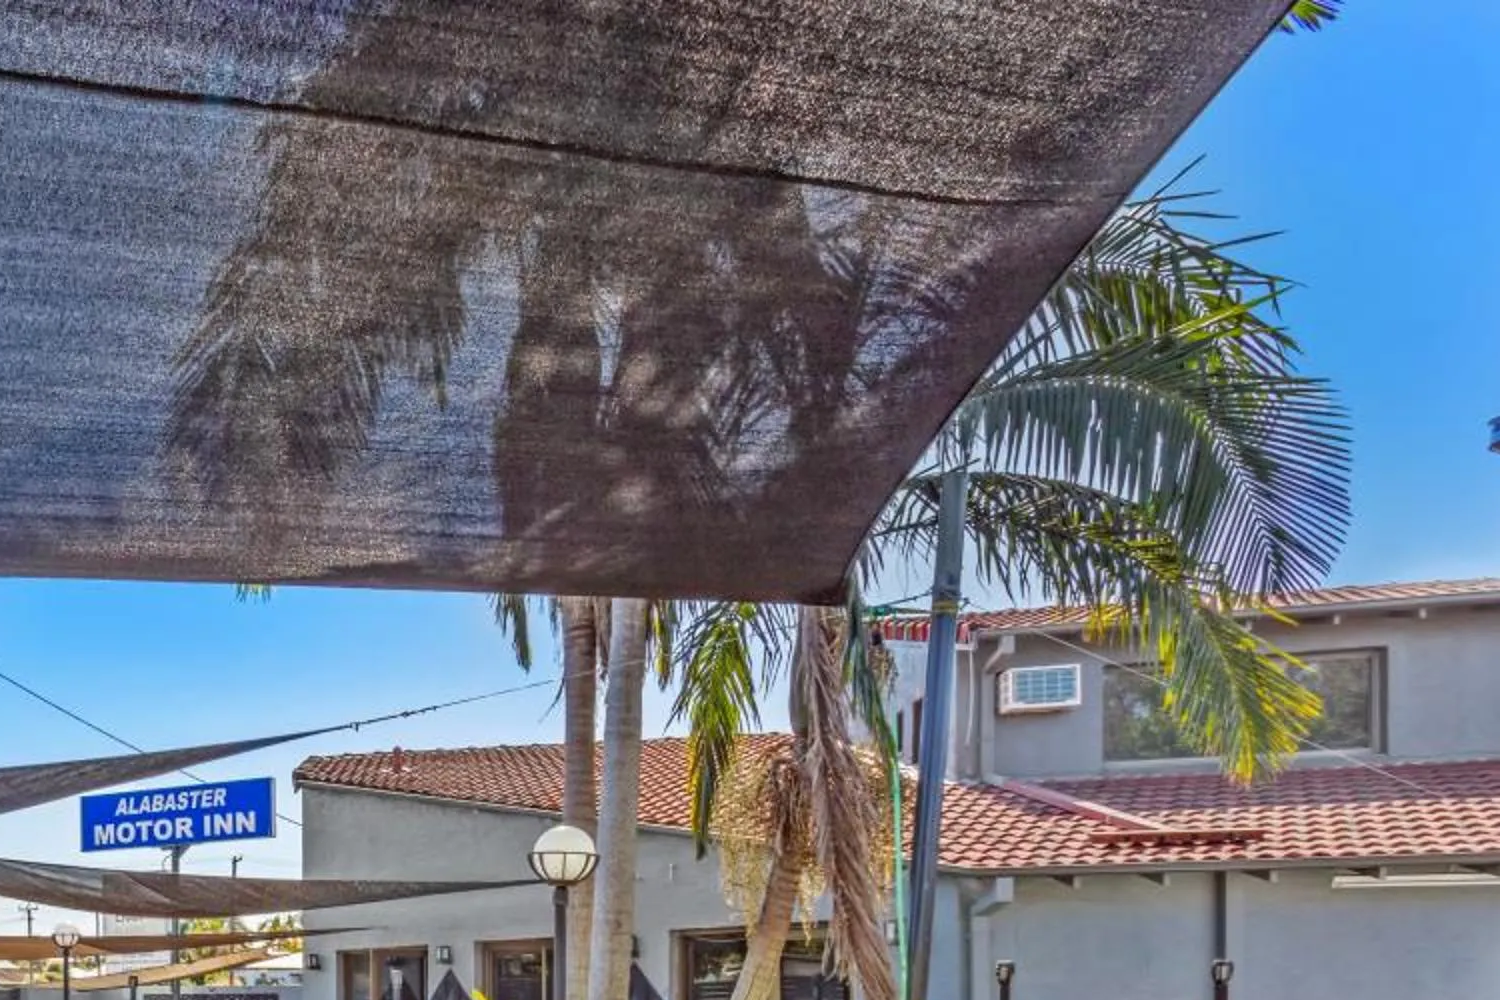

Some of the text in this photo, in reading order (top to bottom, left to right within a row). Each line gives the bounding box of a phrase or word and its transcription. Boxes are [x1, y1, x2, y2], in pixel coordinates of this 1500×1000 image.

[115, 788, 227, 816] ALABASTER
[94, 811, 256, 846] MOTOR INN
